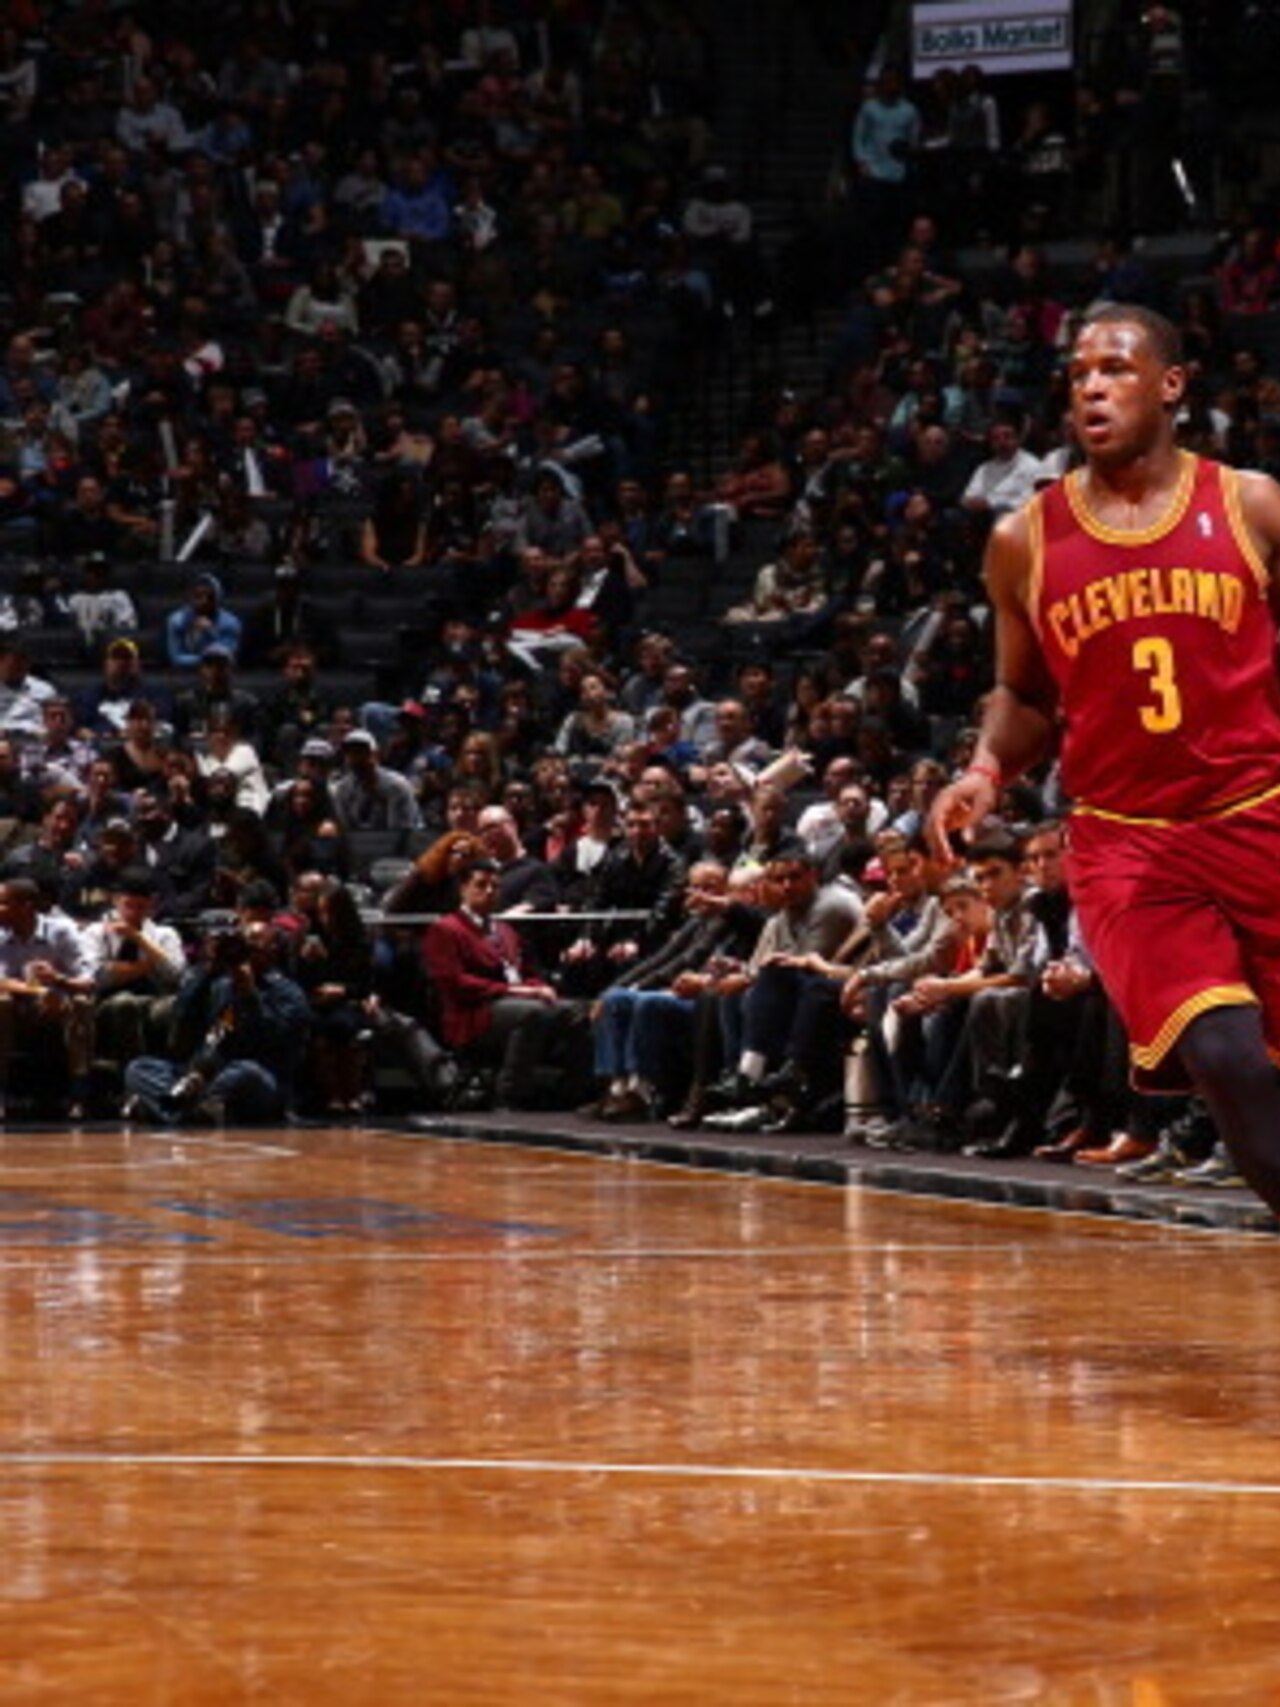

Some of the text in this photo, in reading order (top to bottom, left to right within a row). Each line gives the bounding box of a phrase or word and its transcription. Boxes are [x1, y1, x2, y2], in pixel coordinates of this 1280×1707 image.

[982, 19, 1061, 48] Market
[1048, 567, 1244, 657] CLEVELAND
[1132, 636, 1183, 734] 3
